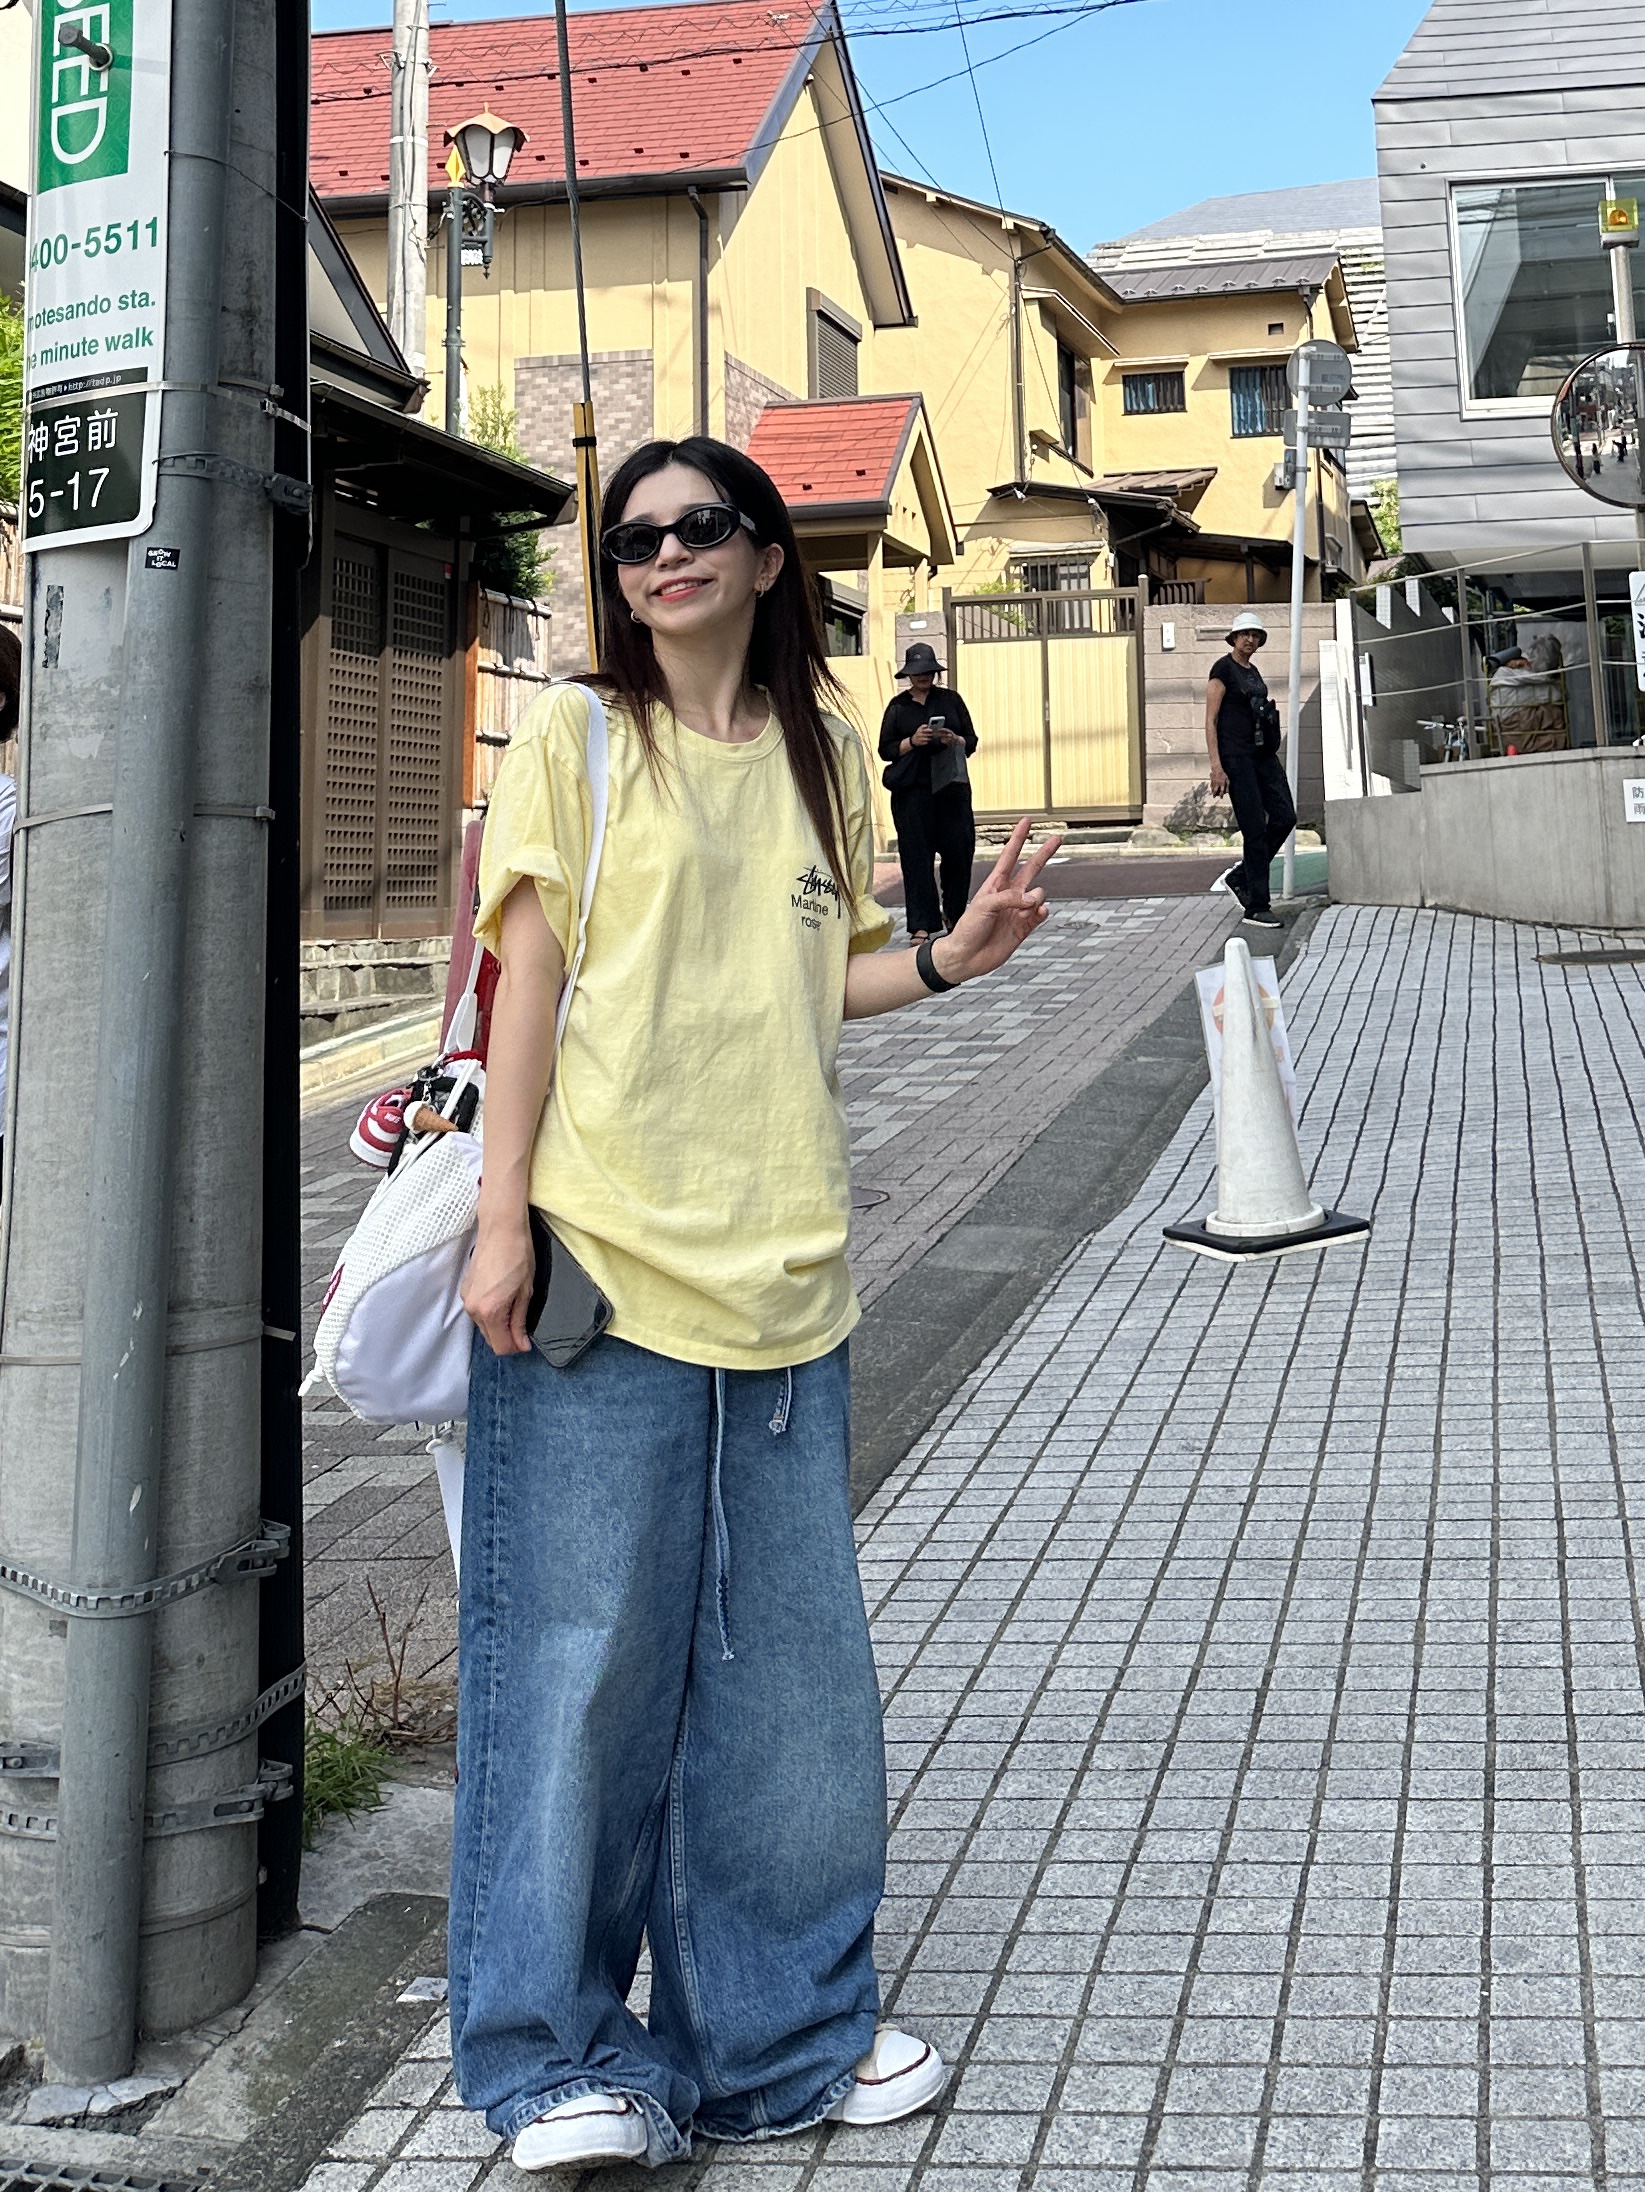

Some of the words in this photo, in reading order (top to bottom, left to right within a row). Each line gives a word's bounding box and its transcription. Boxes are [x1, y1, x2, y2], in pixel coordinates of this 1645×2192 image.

[51, 0, 110, 164] EED
[118, 290, 156, 311] sta.
[40, 336, 99, 366] minute
[105, 326, 154, 352] walk
[28, 408, 119, 463] 神宮前
[29, 468, 110, 518] 5-17
